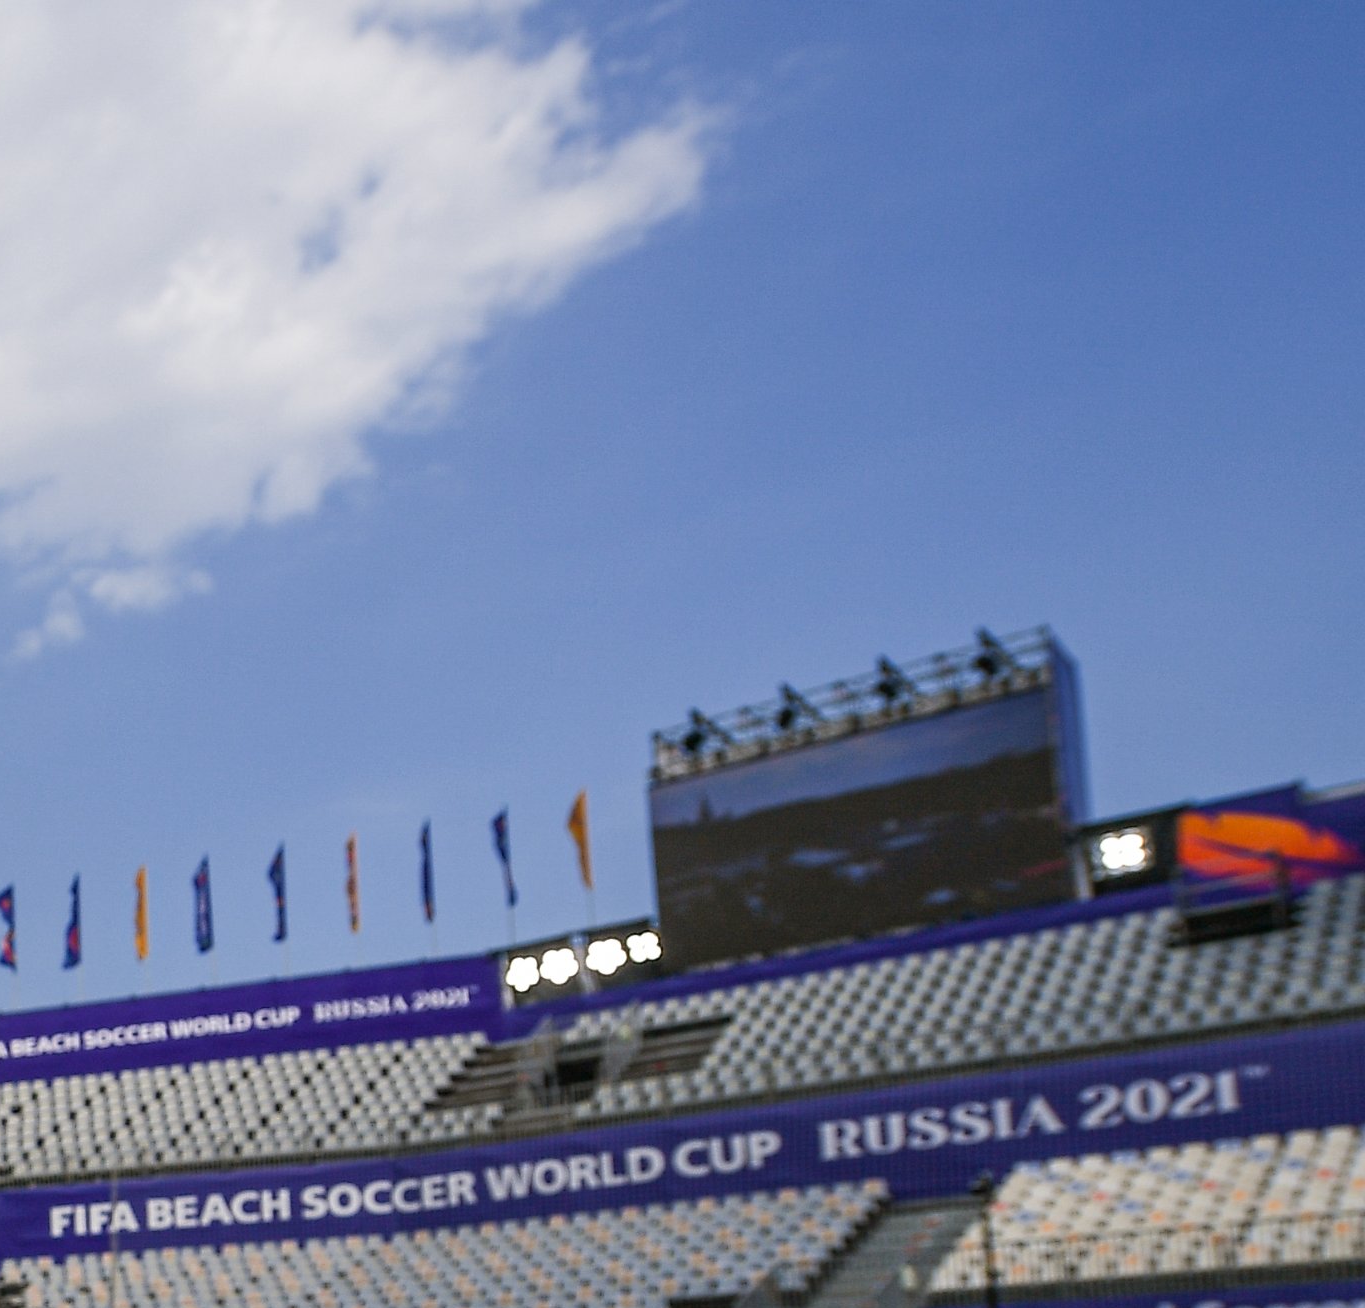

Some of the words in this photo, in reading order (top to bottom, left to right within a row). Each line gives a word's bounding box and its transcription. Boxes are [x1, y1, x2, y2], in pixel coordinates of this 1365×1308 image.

[10, 1033, 80, 1058] BEACH
[82, 1022, 167, 1050] SOCCER
[168, 1012, 253, 1040] WORLD
[254, 1005, 301, 1031] CUP
[313, 995, 409, 1023] RUSSIA
[49, 1203, 138, 1238] FIFA
[146, 1188, 291, 1231] BEACH
[300, 1171, 477, 1220] SOCCER
[484, 1146, 666, 1201] WORLD
[672, 1130, 782, 1178] CUP
[818, 1097, 1067, 1162] RUSSIA
